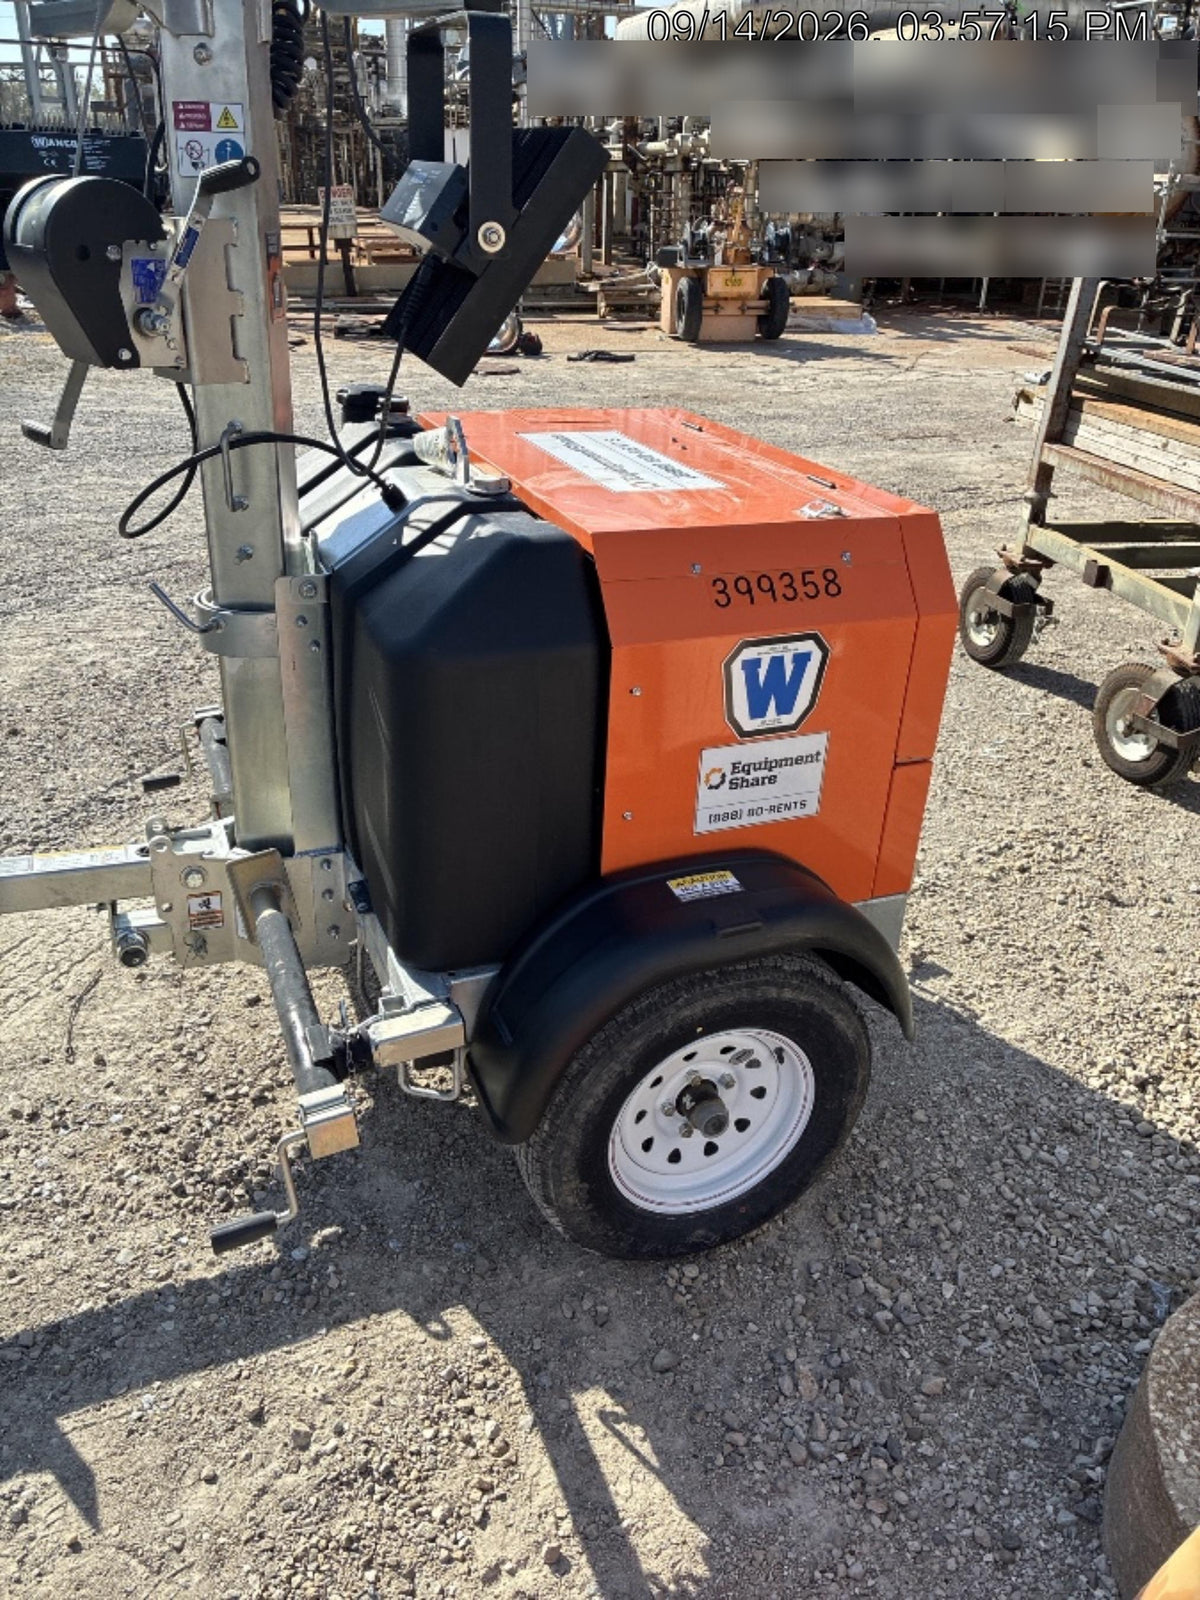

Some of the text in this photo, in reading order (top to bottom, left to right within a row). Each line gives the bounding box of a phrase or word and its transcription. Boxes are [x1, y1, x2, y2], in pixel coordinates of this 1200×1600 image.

[712, 568, 842, 608] 399358
[741, 651, 813, 720] W
[730, 750, 822, 778] Equipment
[728, 773, 778, 790] Share
